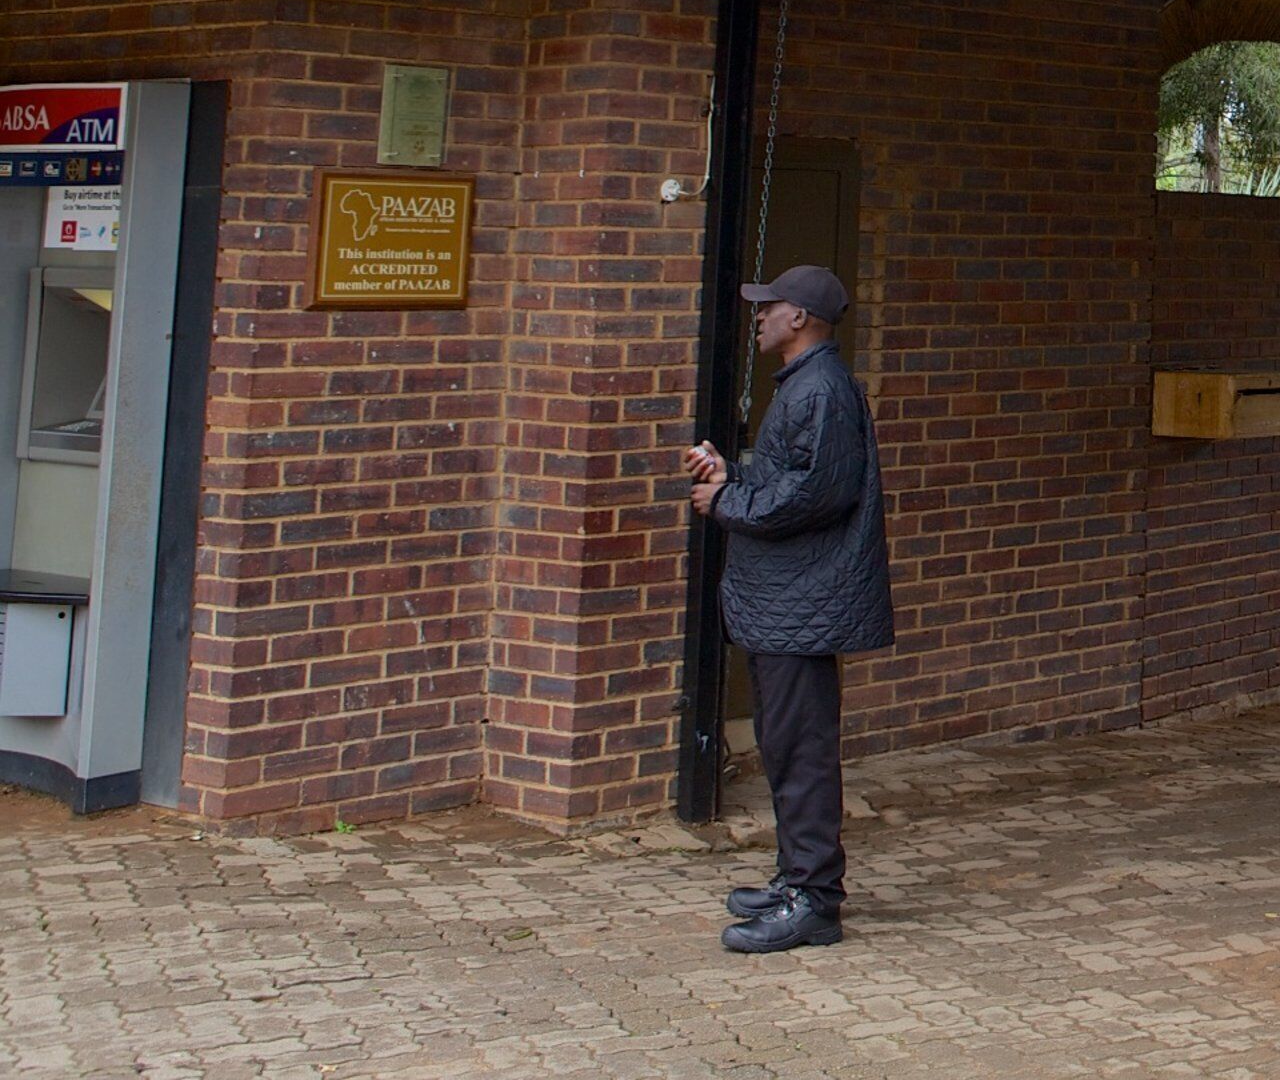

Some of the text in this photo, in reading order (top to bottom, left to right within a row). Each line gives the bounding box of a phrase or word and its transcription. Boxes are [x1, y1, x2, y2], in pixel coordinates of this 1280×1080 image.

[3, 105, 114, 143] ABSA ATM
[64, 189, 77, 202] Buy
[78, 189, 103, 200] airtime
[104, 190, 111, 200] at
[381, 196, 456, 218] PAAZAB
[338, 248, 451, 261] This institution is an
[350, 264, 438, 275] ACCREDITED
[334, 279, 451, 291] member of PAAZAB
